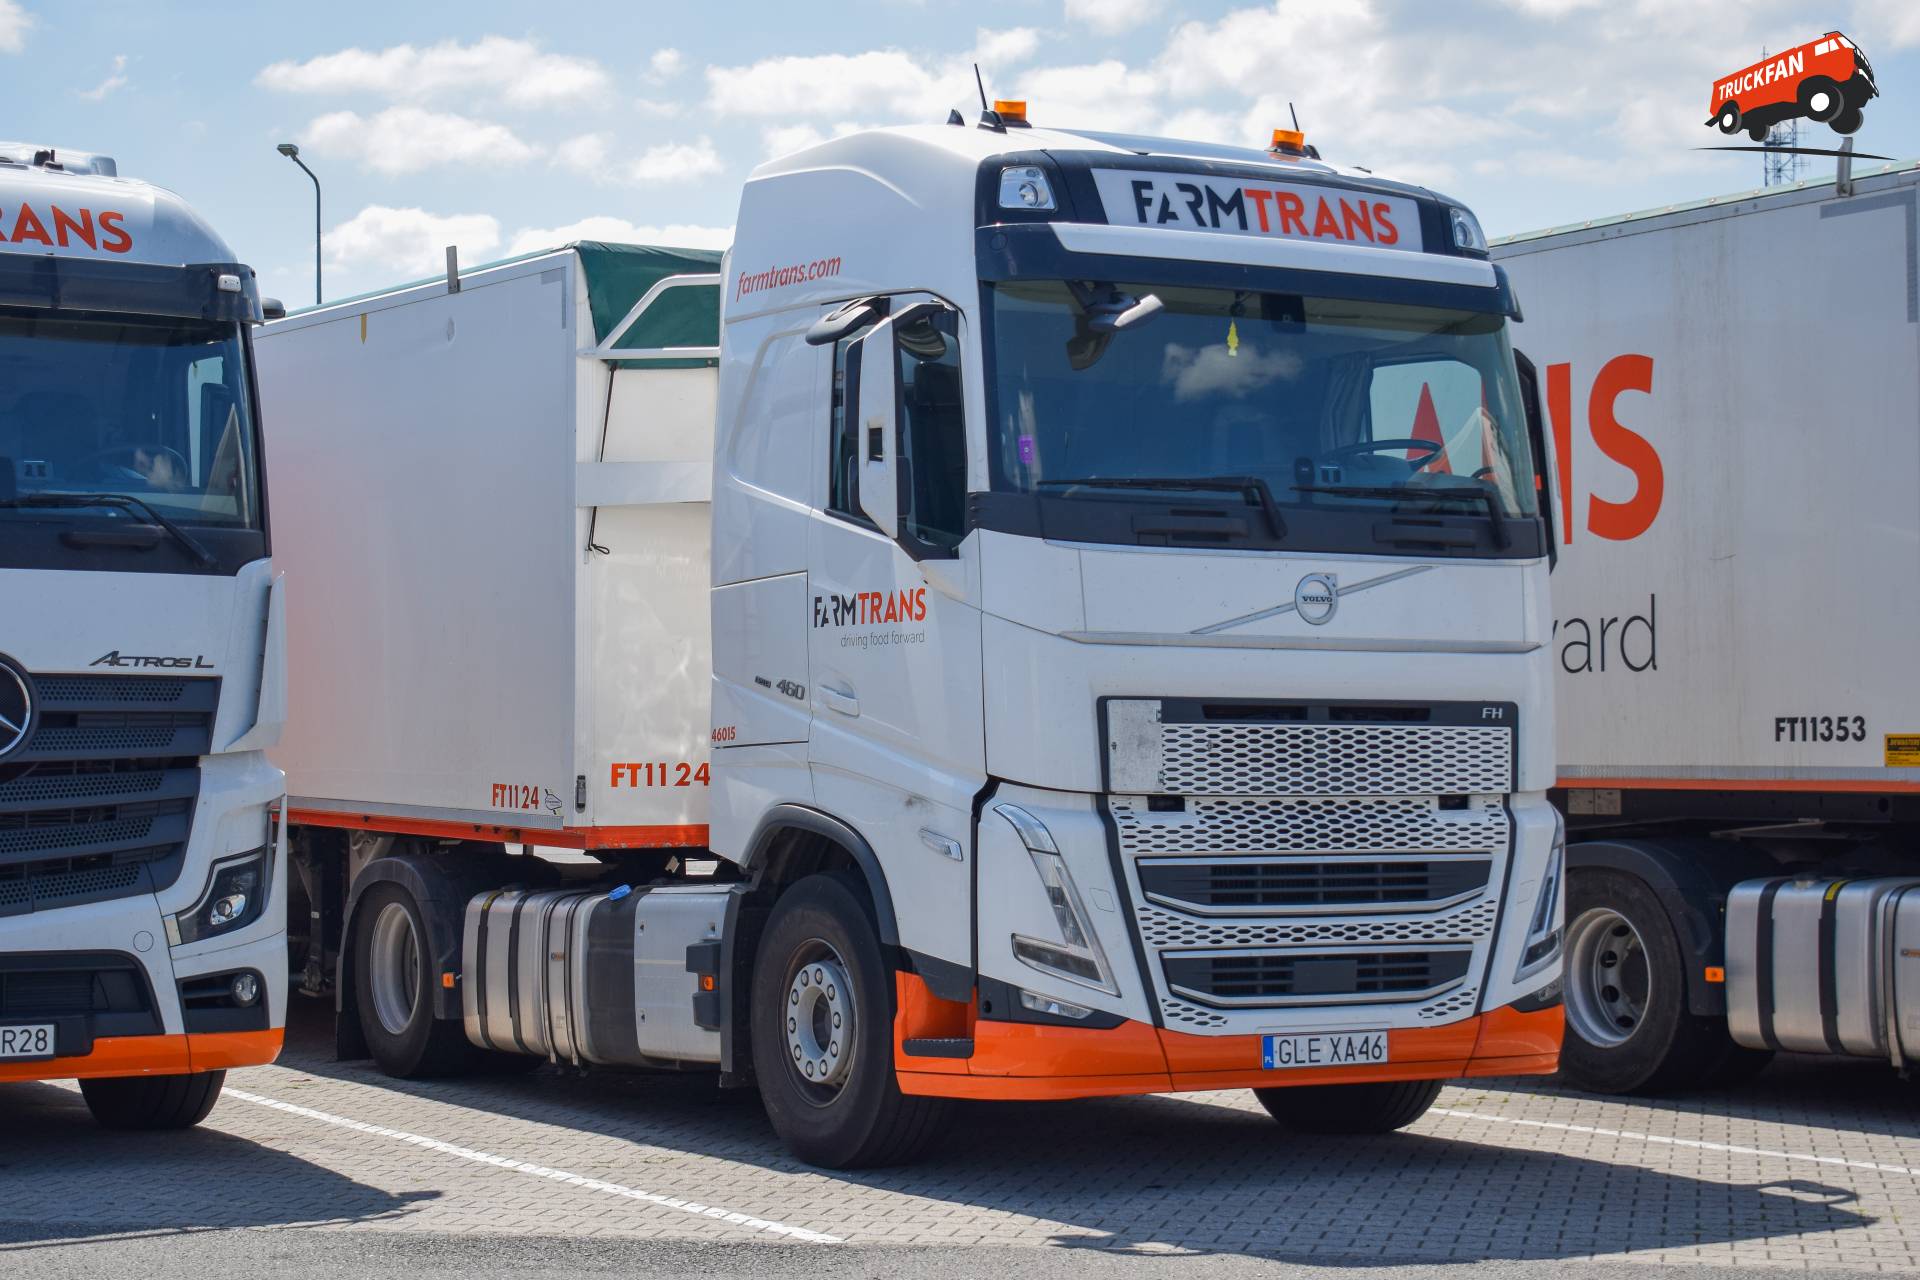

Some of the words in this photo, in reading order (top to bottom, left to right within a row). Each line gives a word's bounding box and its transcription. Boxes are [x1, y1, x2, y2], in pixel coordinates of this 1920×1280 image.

[1130, 179, 1399, 246] FARMTRANS
[736, 255, 841, 303] farmtrans.com
[814, 587, 927, 628] FARMTRANS
[1302, 595, 1333, 603] VOLVO
[840, 632, 868, 650] driving
[870, 631, 889, 646] food
[891, 628, 925, 645] forward
[1552, 593, 1657, 674] ard
[194, 655, 214, 668] L
[776, 679, 805, 701] 460
[1482, 707, 1503, 719] FH
[1774, 715, 1866, 742] FT11353
[2, 1028, 48, 1054] R28
[1264, 1055, 1273, 1064] PL
[1279, 1038, 1321, 1064] GLE
[1329, 1035, 1383, 1063] XA46
